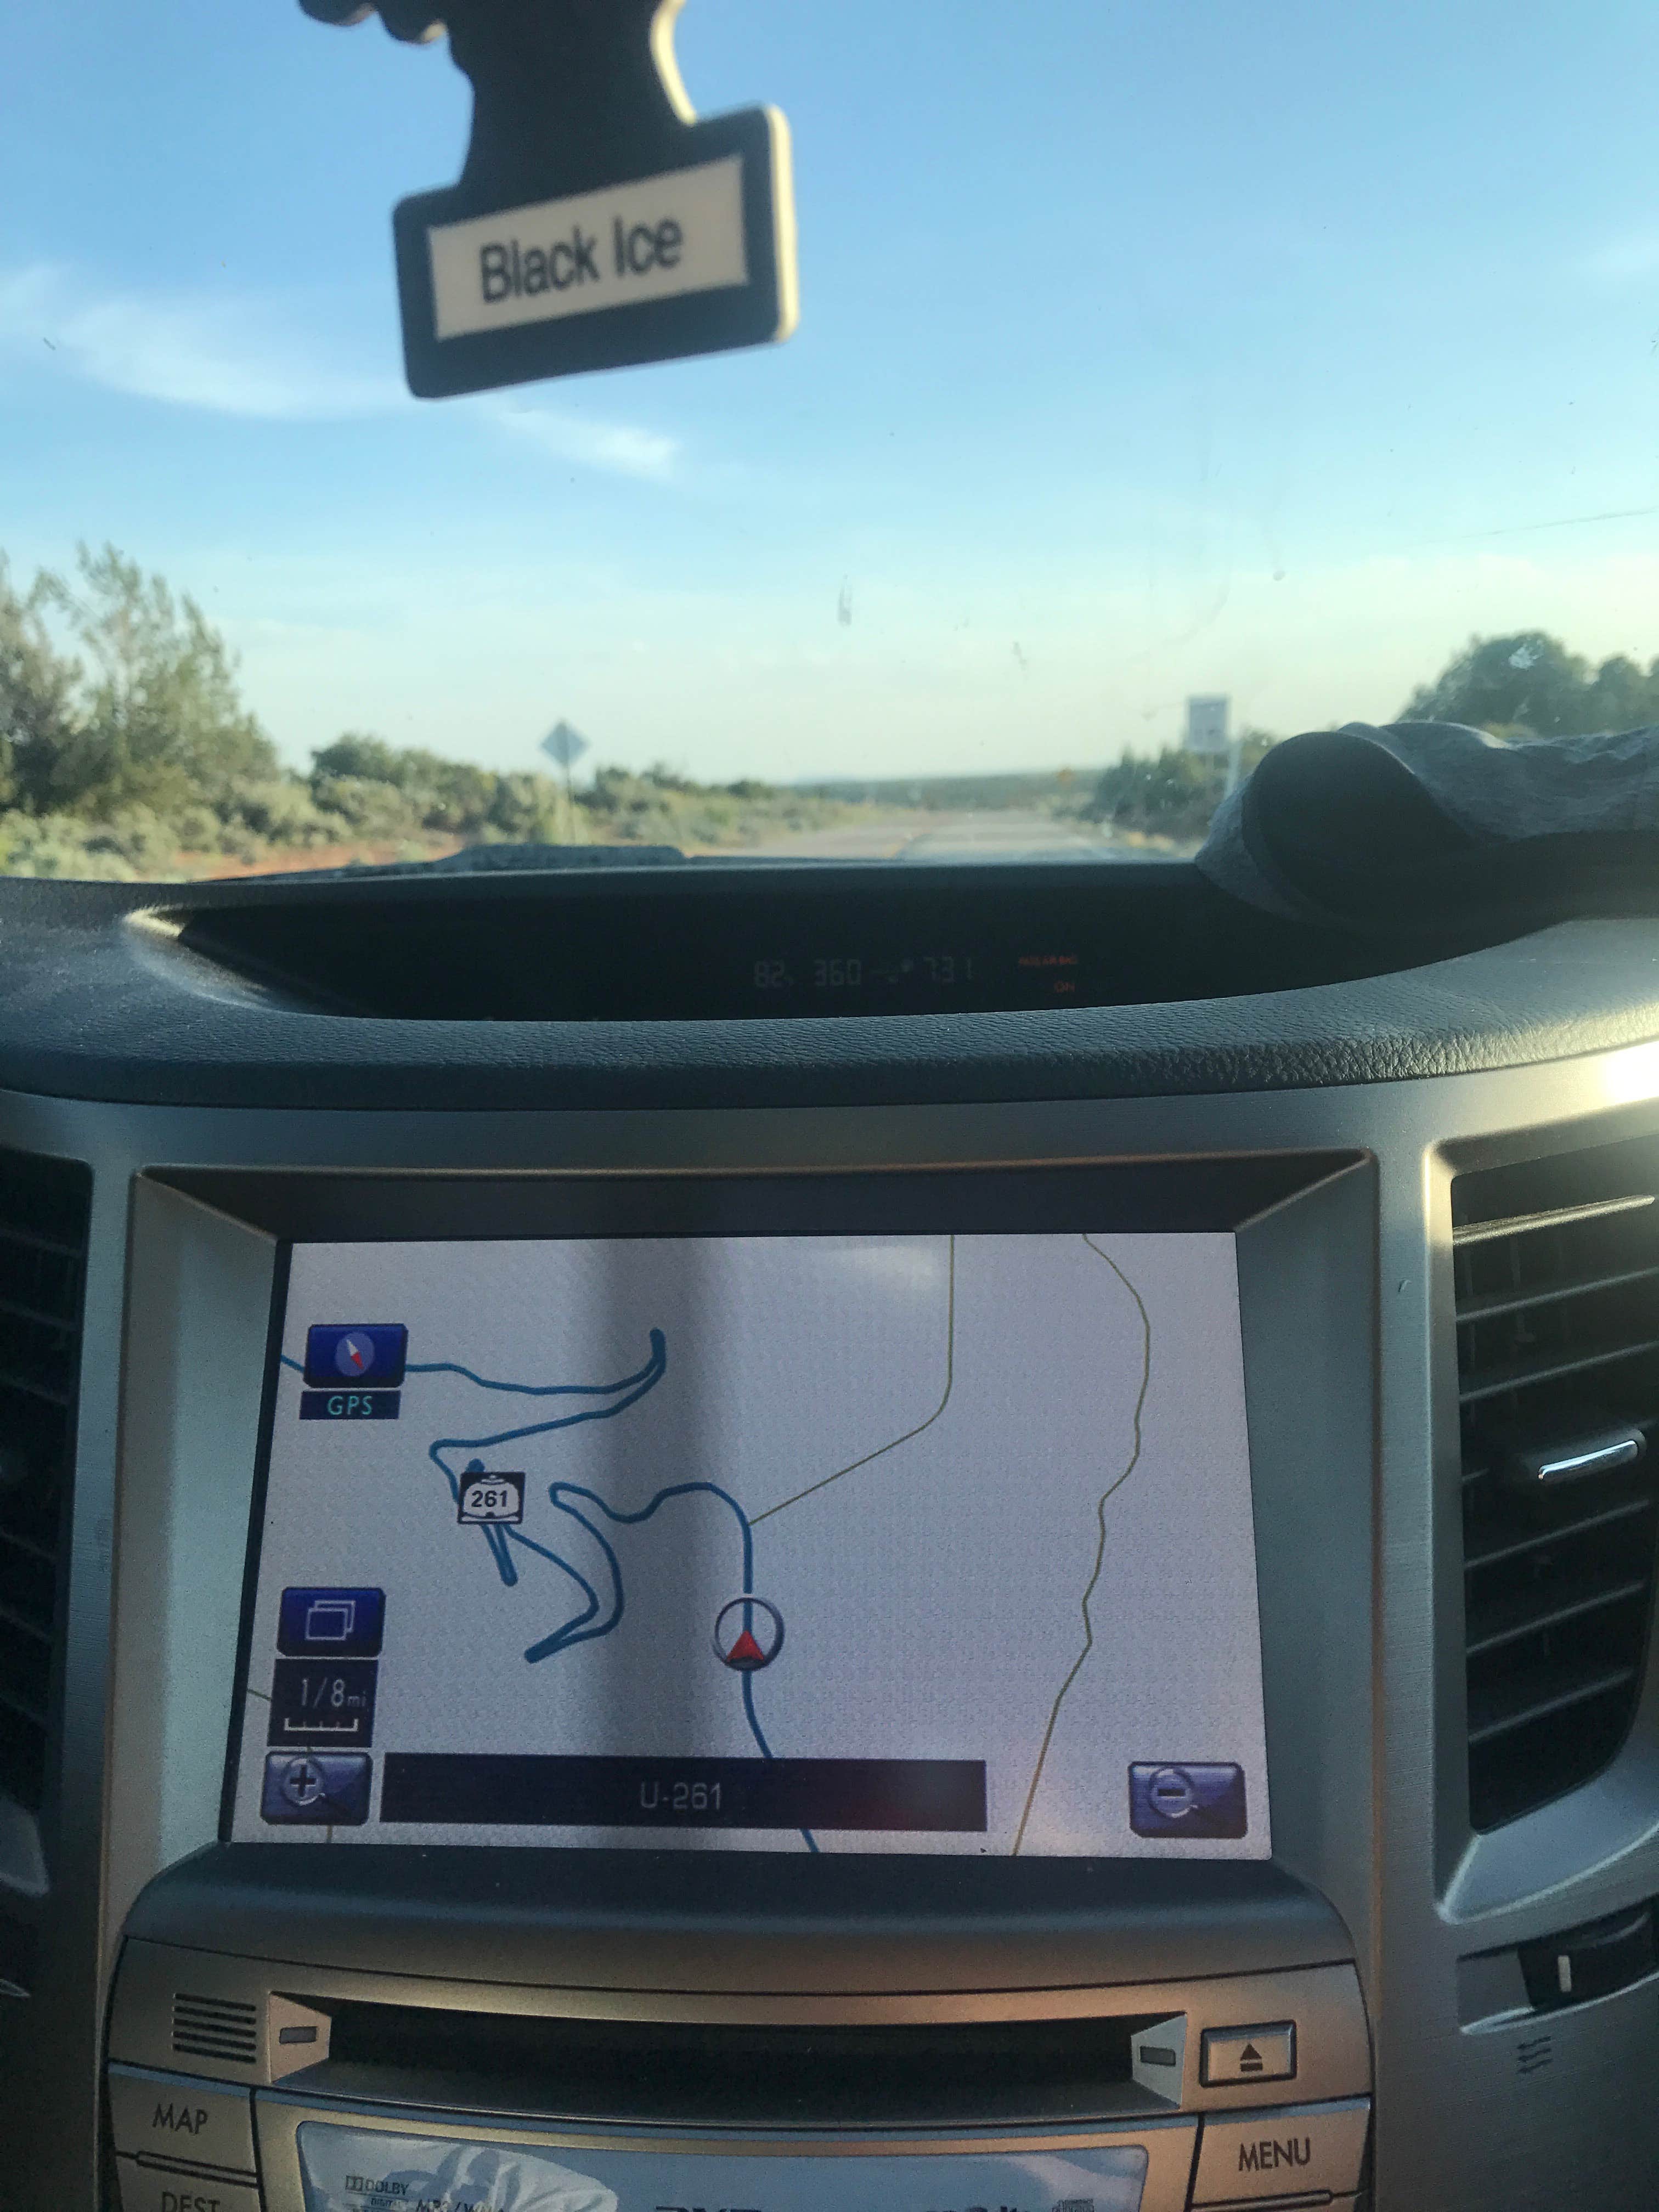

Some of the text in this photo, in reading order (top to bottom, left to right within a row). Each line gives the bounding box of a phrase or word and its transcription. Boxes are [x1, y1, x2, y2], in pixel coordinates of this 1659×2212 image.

[479, 213, 682, 304] Black Ice
[328, 1396, 373, 1415] GPS
[471, 1490, 507, 1508] 261
[640, 1782, 721, 1810] U-261
[153, 2102, 208, 2135] MAP
[1238, 2137, 1311, 2172] MENU
[366, 2179, 409, 2196] DOLBY
